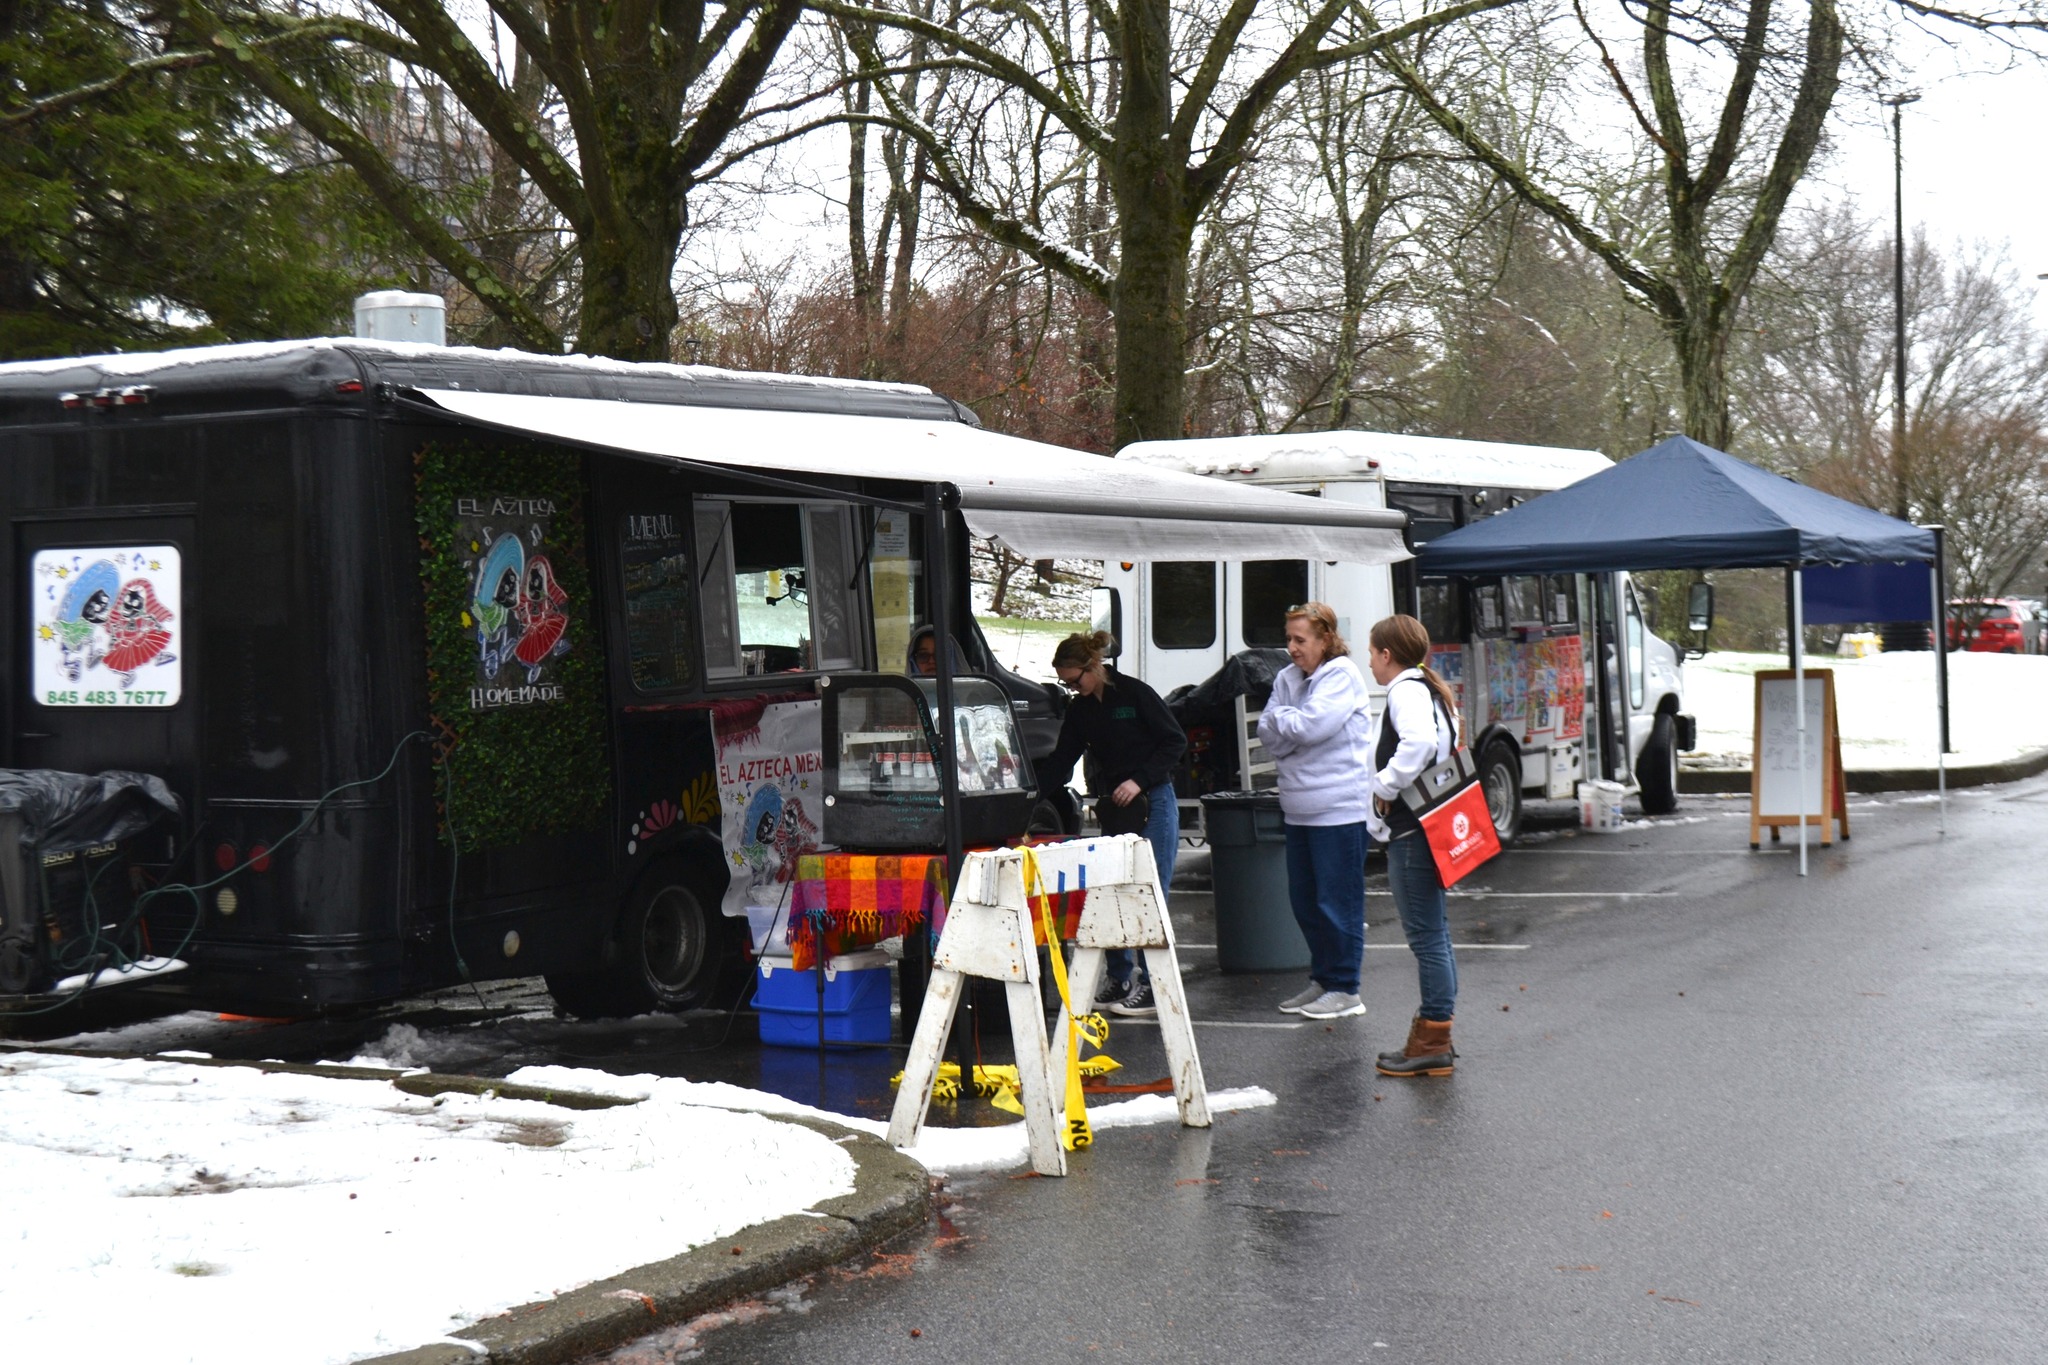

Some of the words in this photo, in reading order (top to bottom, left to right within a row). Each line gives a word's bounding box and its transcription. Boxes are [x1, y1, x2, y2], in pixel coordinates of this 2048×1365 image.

[457, 498, 485, 517] EL
[490, 496, 557, 516] AZTECA
[629, 514, 673, 537] MENU
[47, 691, 78, 704] 845
[84, 691, 117, 704] 483
[123, 691, 167, 704] 7677
[471, 683, 565, 709] HOMEMADE
[720, 765, 735, 785] EL
[738, 757, 792, 782] AZTECA
